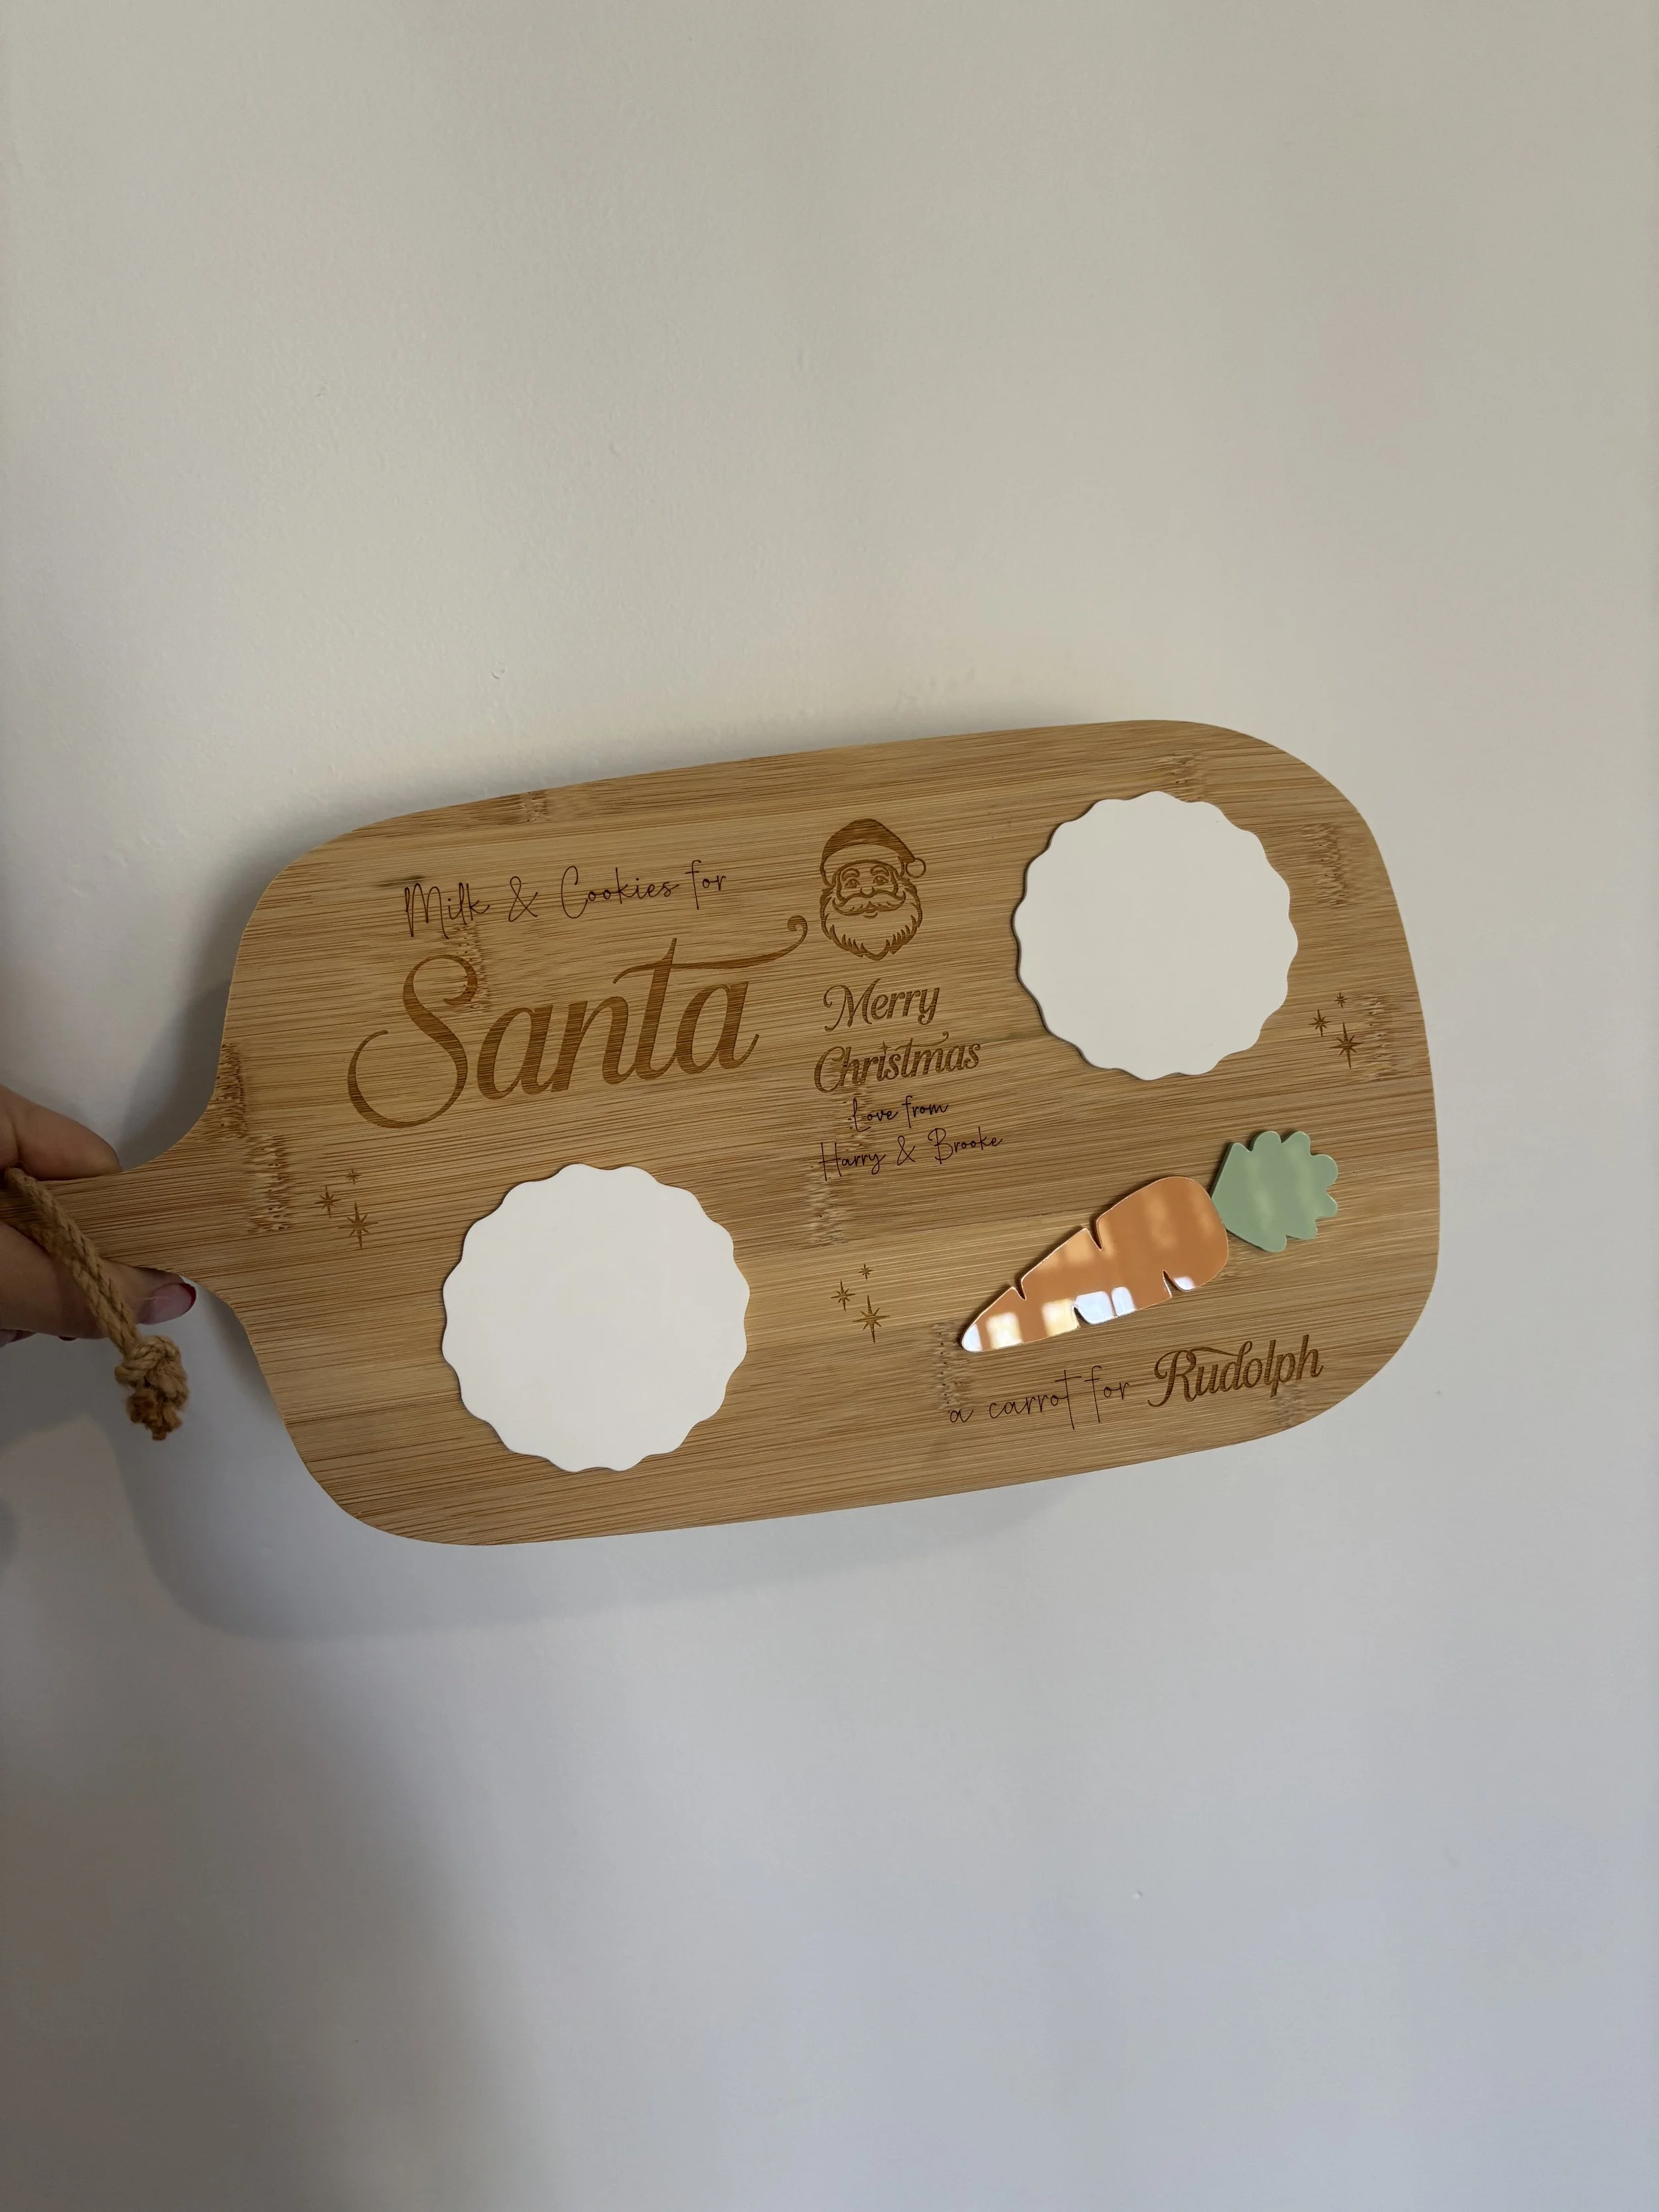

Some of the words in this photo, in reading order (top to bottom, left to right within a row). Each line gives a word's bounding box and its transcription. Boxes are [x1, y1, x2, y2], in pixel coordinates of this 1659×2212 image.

[404, 882, 490, 940] Milk
[508, 875, 538, 922] &
[560, 865, 680, 919] Cookies
[684, 859, 727, 910] for
[347, 915, 808, 1128] Santa
[823, 978, 940, 1032] Merry
[814, 1031, 981, 1093] Christmas
[852, 1097, 899, 1133] Love
[901, 1095, 949, 1129] from
[818, 1142, 886, 1182] Harry
[897, 1136, 916, 1166] &
[927, 1126, 1003, 1165] Brooke
[949, 1406, 974, 1424] a
[988, 1369, 1082, 1430] carrot
[1084, 1364, 1130, 1424] for
[1147, 1334, 1324, 1408] Rudolph
